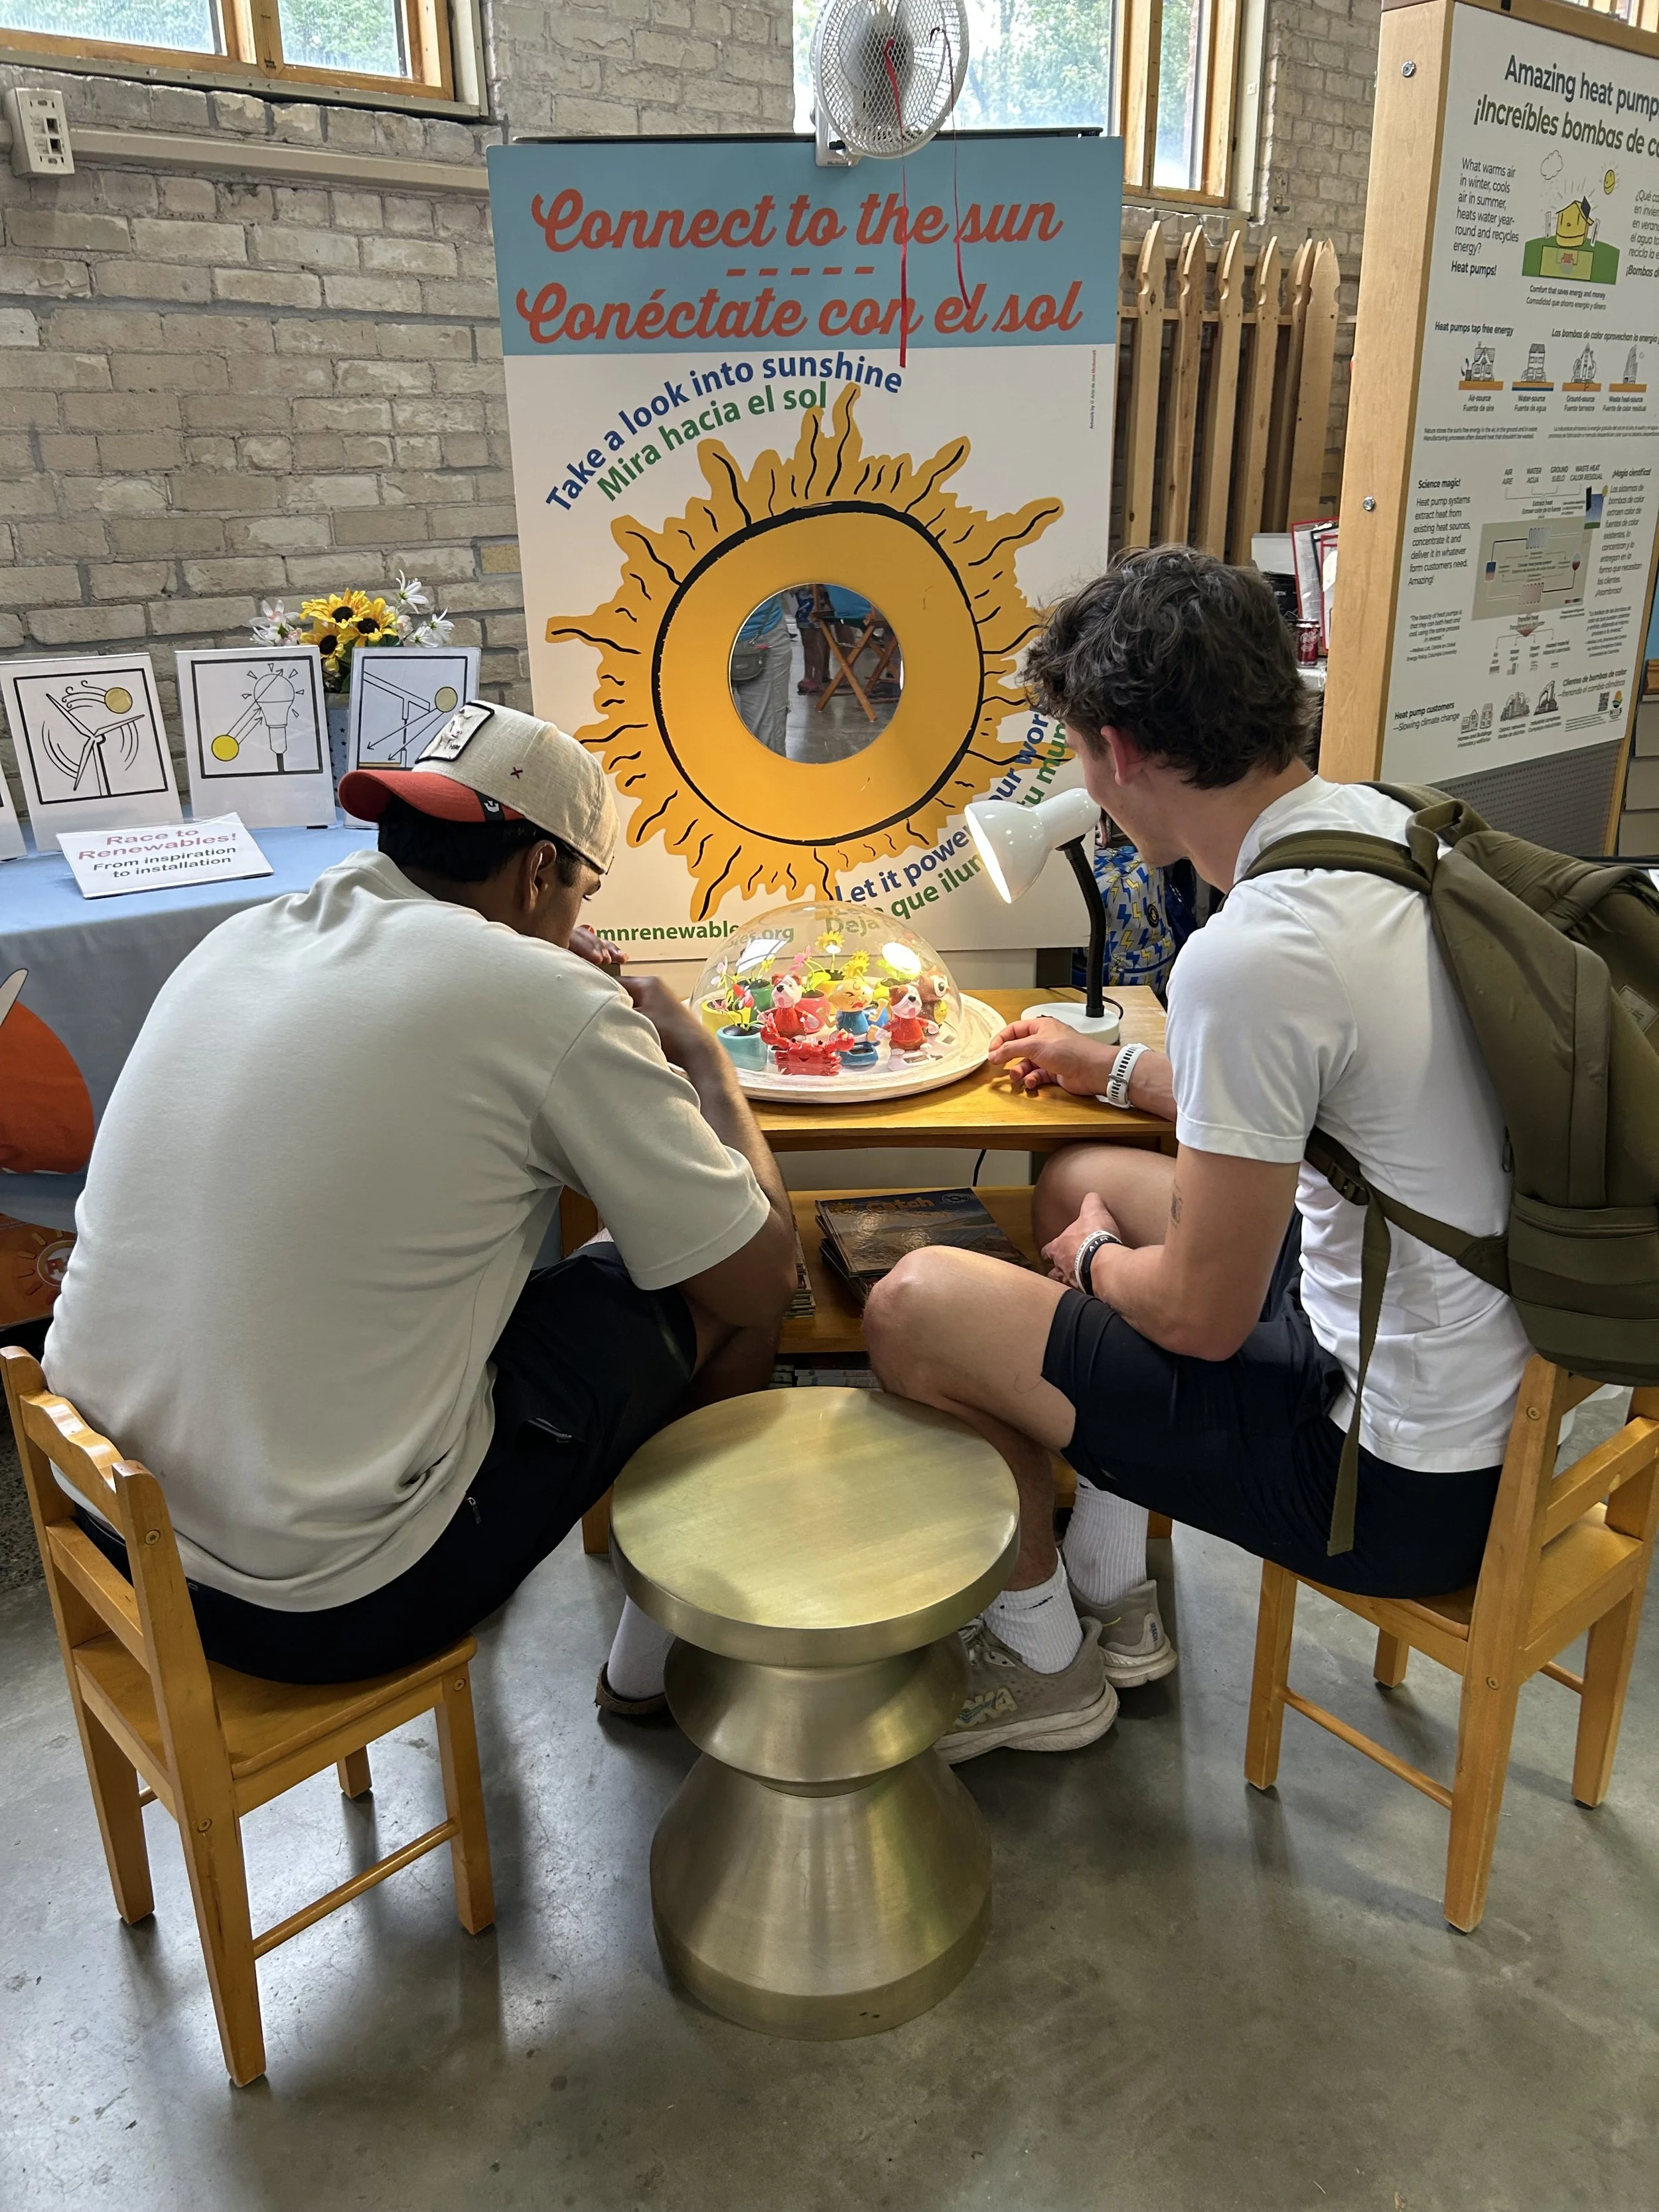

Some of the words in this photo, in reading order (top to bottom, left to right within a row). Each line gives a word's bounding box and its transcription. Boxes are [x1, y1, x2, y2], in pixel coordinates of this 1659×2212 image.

[1504, 54, 1576, 103] Amazing
[1580, 72, 1613, 106] heat
[1616, 88, 1659, 122] pump
[1473, 94, 1559, 136] ¡Increíbles
[1561, 111, 1624, 149] bombas
[1626, 127, 1644, 154] de
[1463, 157, 1481, 173] What
[1482, 164, 1506, 177] warms
[1507, 165, 1516, 178] air
[1460, 173, 1467, 186] in
[1469, 176, 1491, 192] winter,
[1492, 181, 1510, 193] cools
[1458, 190, 1467, 202] air
[1469, 192, 1475, 204] in
[1477, 197, 1506, 210] summer,
[1457, 206, 1476, 220] heats
[1478, 212, 1497, 224] water
[1497, 215, 1515, 227] year-
[1634, 205, 1642, 214] en
[532, 188, 776, 252] Connect
[786, 195, 847, 247] to
[856, 194, 948, 246] the
[956, 200, 1063, 243] sun
[1632, 220, 1640, 228] en
[1455, 225, 1476, 236] round
[1477, 227, 1490, 239] and
[1492, 229, 1519, 244] recycles
[1630, 232, 1636, 242] el
[1637, 236, 1652, 246] agua
[1453, 241, 1482, 256] energy?
[1649, 248, 1654, 259] la
[1451, 259, 1468, 273] Heat
[1470, 264, 1497, 277] pumps!
[1530, 285, 1548, 293] Comfort
[516, 281, 805, 343] Conéctate
[818, 297, 924, 336] con
[934, 283, 987, 333] el
[992, 281, 1084, 332] sol
[1435, 321, 1449, 331] Heat
[1449, 324, 1471, 334] pumps
[1471, 324, 1481, 335] tap
[1482, 323, 1493, 333] free
[1494, 327, 1514, 337] energy
[1561, 329, 1583, 338] bombas
[545, 447, 607, 510] Take
[605, 428, 625, 451] a
[618, 380, 690, 435] look
[690, 359, 754, 397] into
[763, 352, 903, 394] sunshine
[597, 444, 662, 502] Mira
[658, 401, 741, 451] hacia
[748, 385, 774, 415] el
[784, 382, 827, 410] sol
[1418, 479, 1441, 489] Science
[1441, 478, 1461, 489] magic!
[1416, 498, 1430, 506] Heat
[1430, 498, 1447, 507] pump
[1448, 496, 1471, 507] systems
[1415, 511, 1434, 520] extract
[1435, 510, 1448, 519] heat
[1449, 508, 1462, 518] from
[1413, 524, 1435, 534] existing
[1435, 523, 1449, 532] heat
[1449, 522, 1471, 531] sources,
[1412, 536, 1445, 546] concentrate
[1450, 534, 1461, 543] and
[1411, 550, 1429, 559] deliver
[1435, 549, 1441, 557] in
[1441, 548, 1467, 557] whatever
[1409, 564, 1423, 573] form
[1423, 561, 1452, 571] customers
[1408, 575, 1434, 585] Amazing!
[1395, 711, 1407, 719] Heat
[1409, 708, 1425, 718] pump
[1427, 702, 1455, 713] customers
[1421, 717, 1439, 726] climate
[1441, 712, 1460, 722] change
[835, 879, 877, 903] Let
[879, 870, 902, 893] it
[1015, 713, 1048, 765] wor
[891, 885, 940, 920] que
[1037, 723, 1066, 784] mun
[78, 833, 237, 860] Renewables!
[106, 832, 169, 845] Race
[93, 858, 139, 871] From
[145, 847, 236, 864] inspiration
[136, 857, 231, 875] installation
